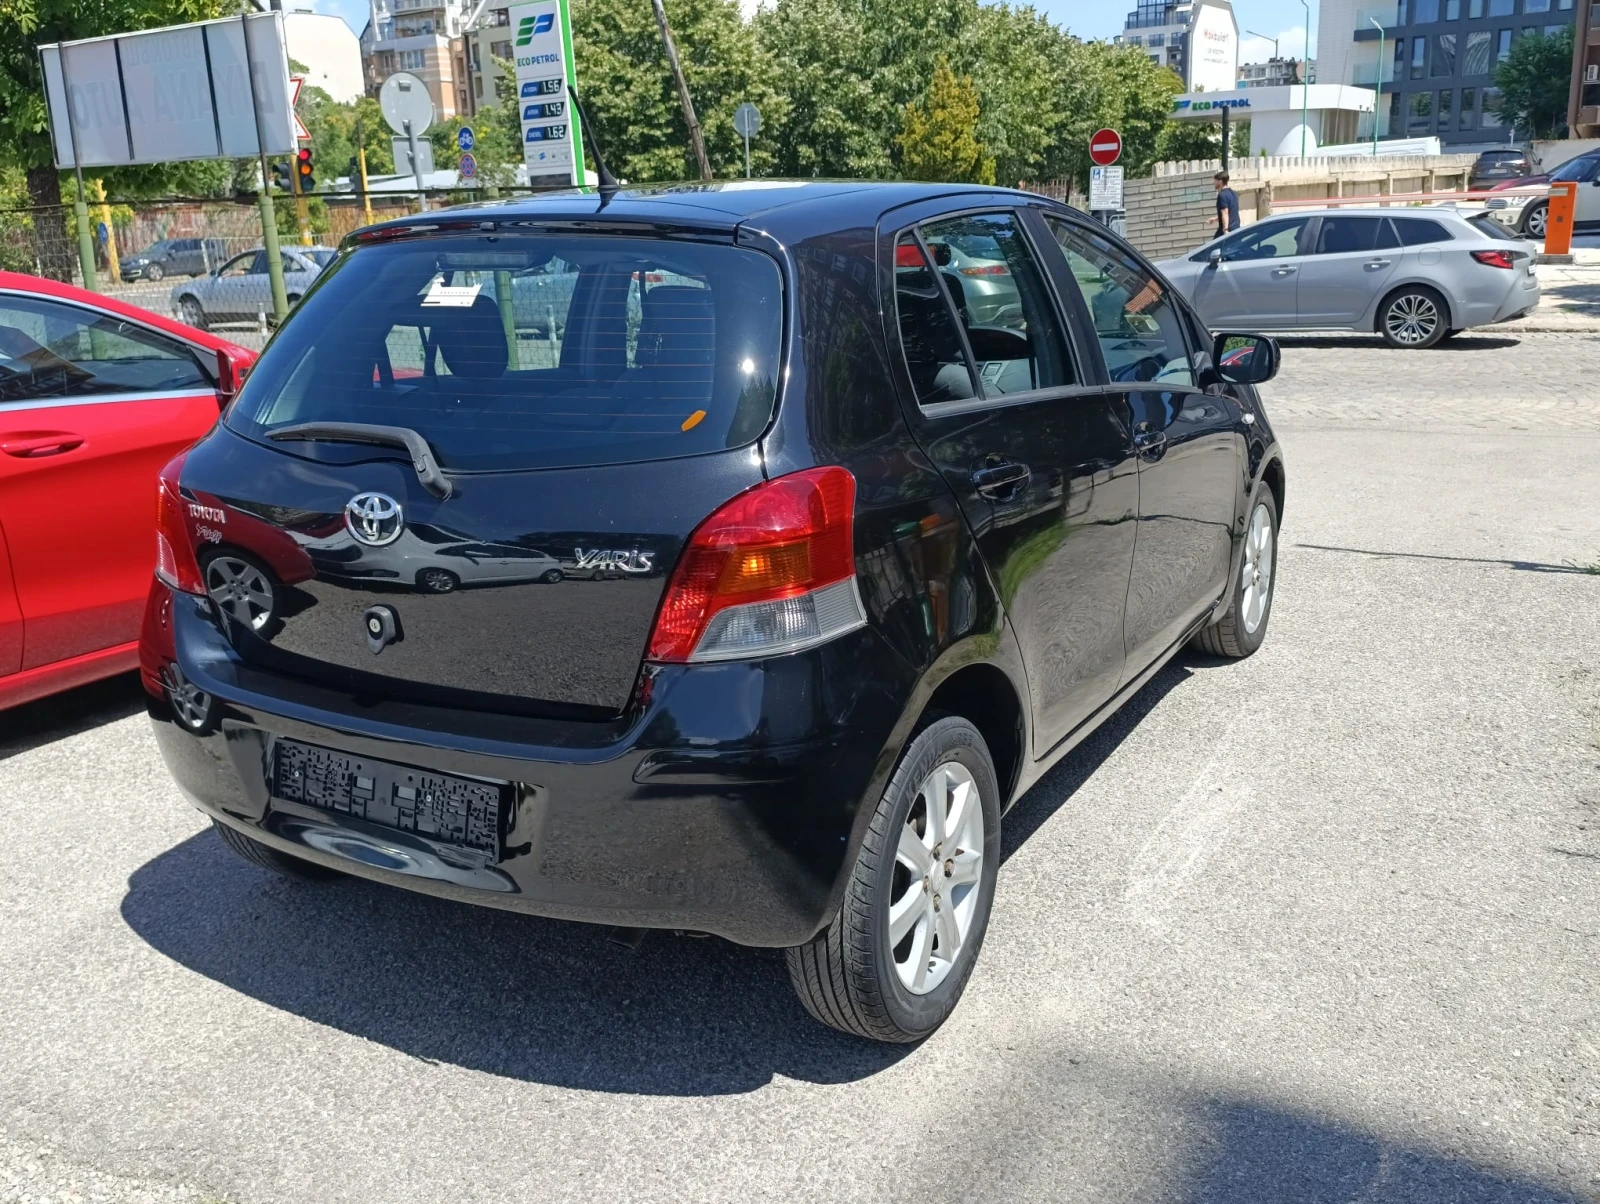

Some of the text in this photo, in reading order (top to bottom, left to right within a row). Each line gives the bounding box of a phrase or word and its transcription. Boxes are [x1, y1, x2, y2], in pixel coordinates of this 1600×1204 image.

[542, 80, 560, 93] 1.56
[545, 103, 562, 116] 1.43
[547, 126, 564, 139] 1.62
[188, 503, 226, 524] TOYOTA
